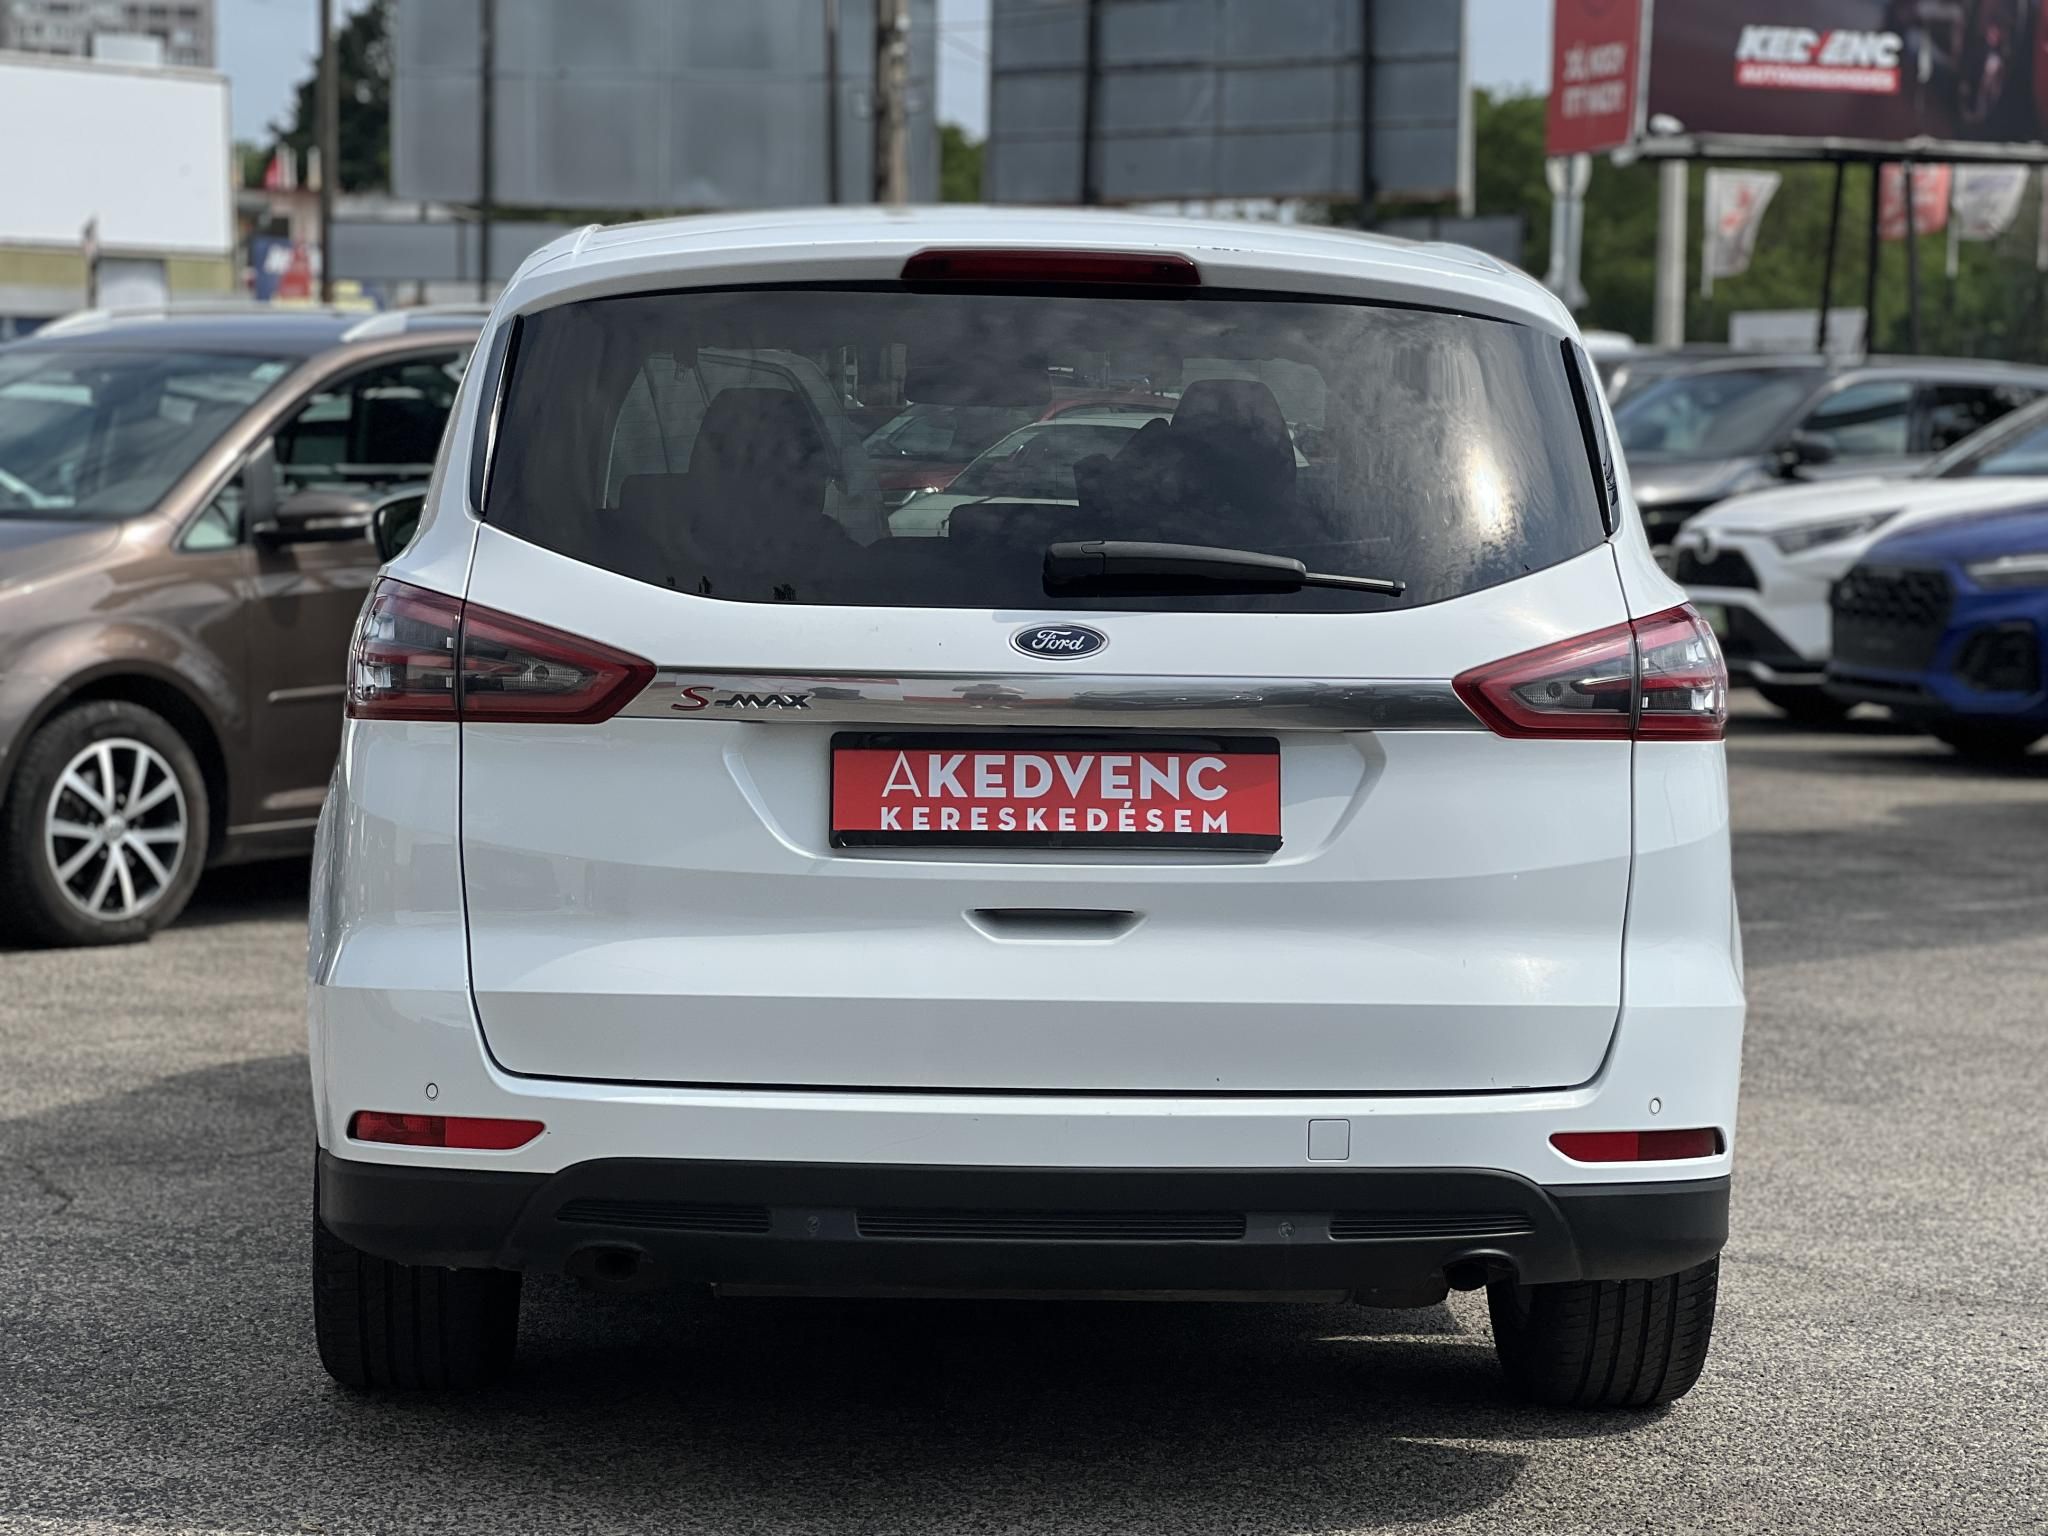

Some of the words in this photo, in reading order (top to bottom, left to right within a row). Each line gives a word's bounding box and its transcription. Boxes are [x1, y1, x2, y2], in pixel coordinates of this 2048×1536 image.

[1031, 629, 1085, 651] Ford
[671, 686, 813, 711] S-MAX
[880, 802, 1229, 834] KERESKEDÉSEM
